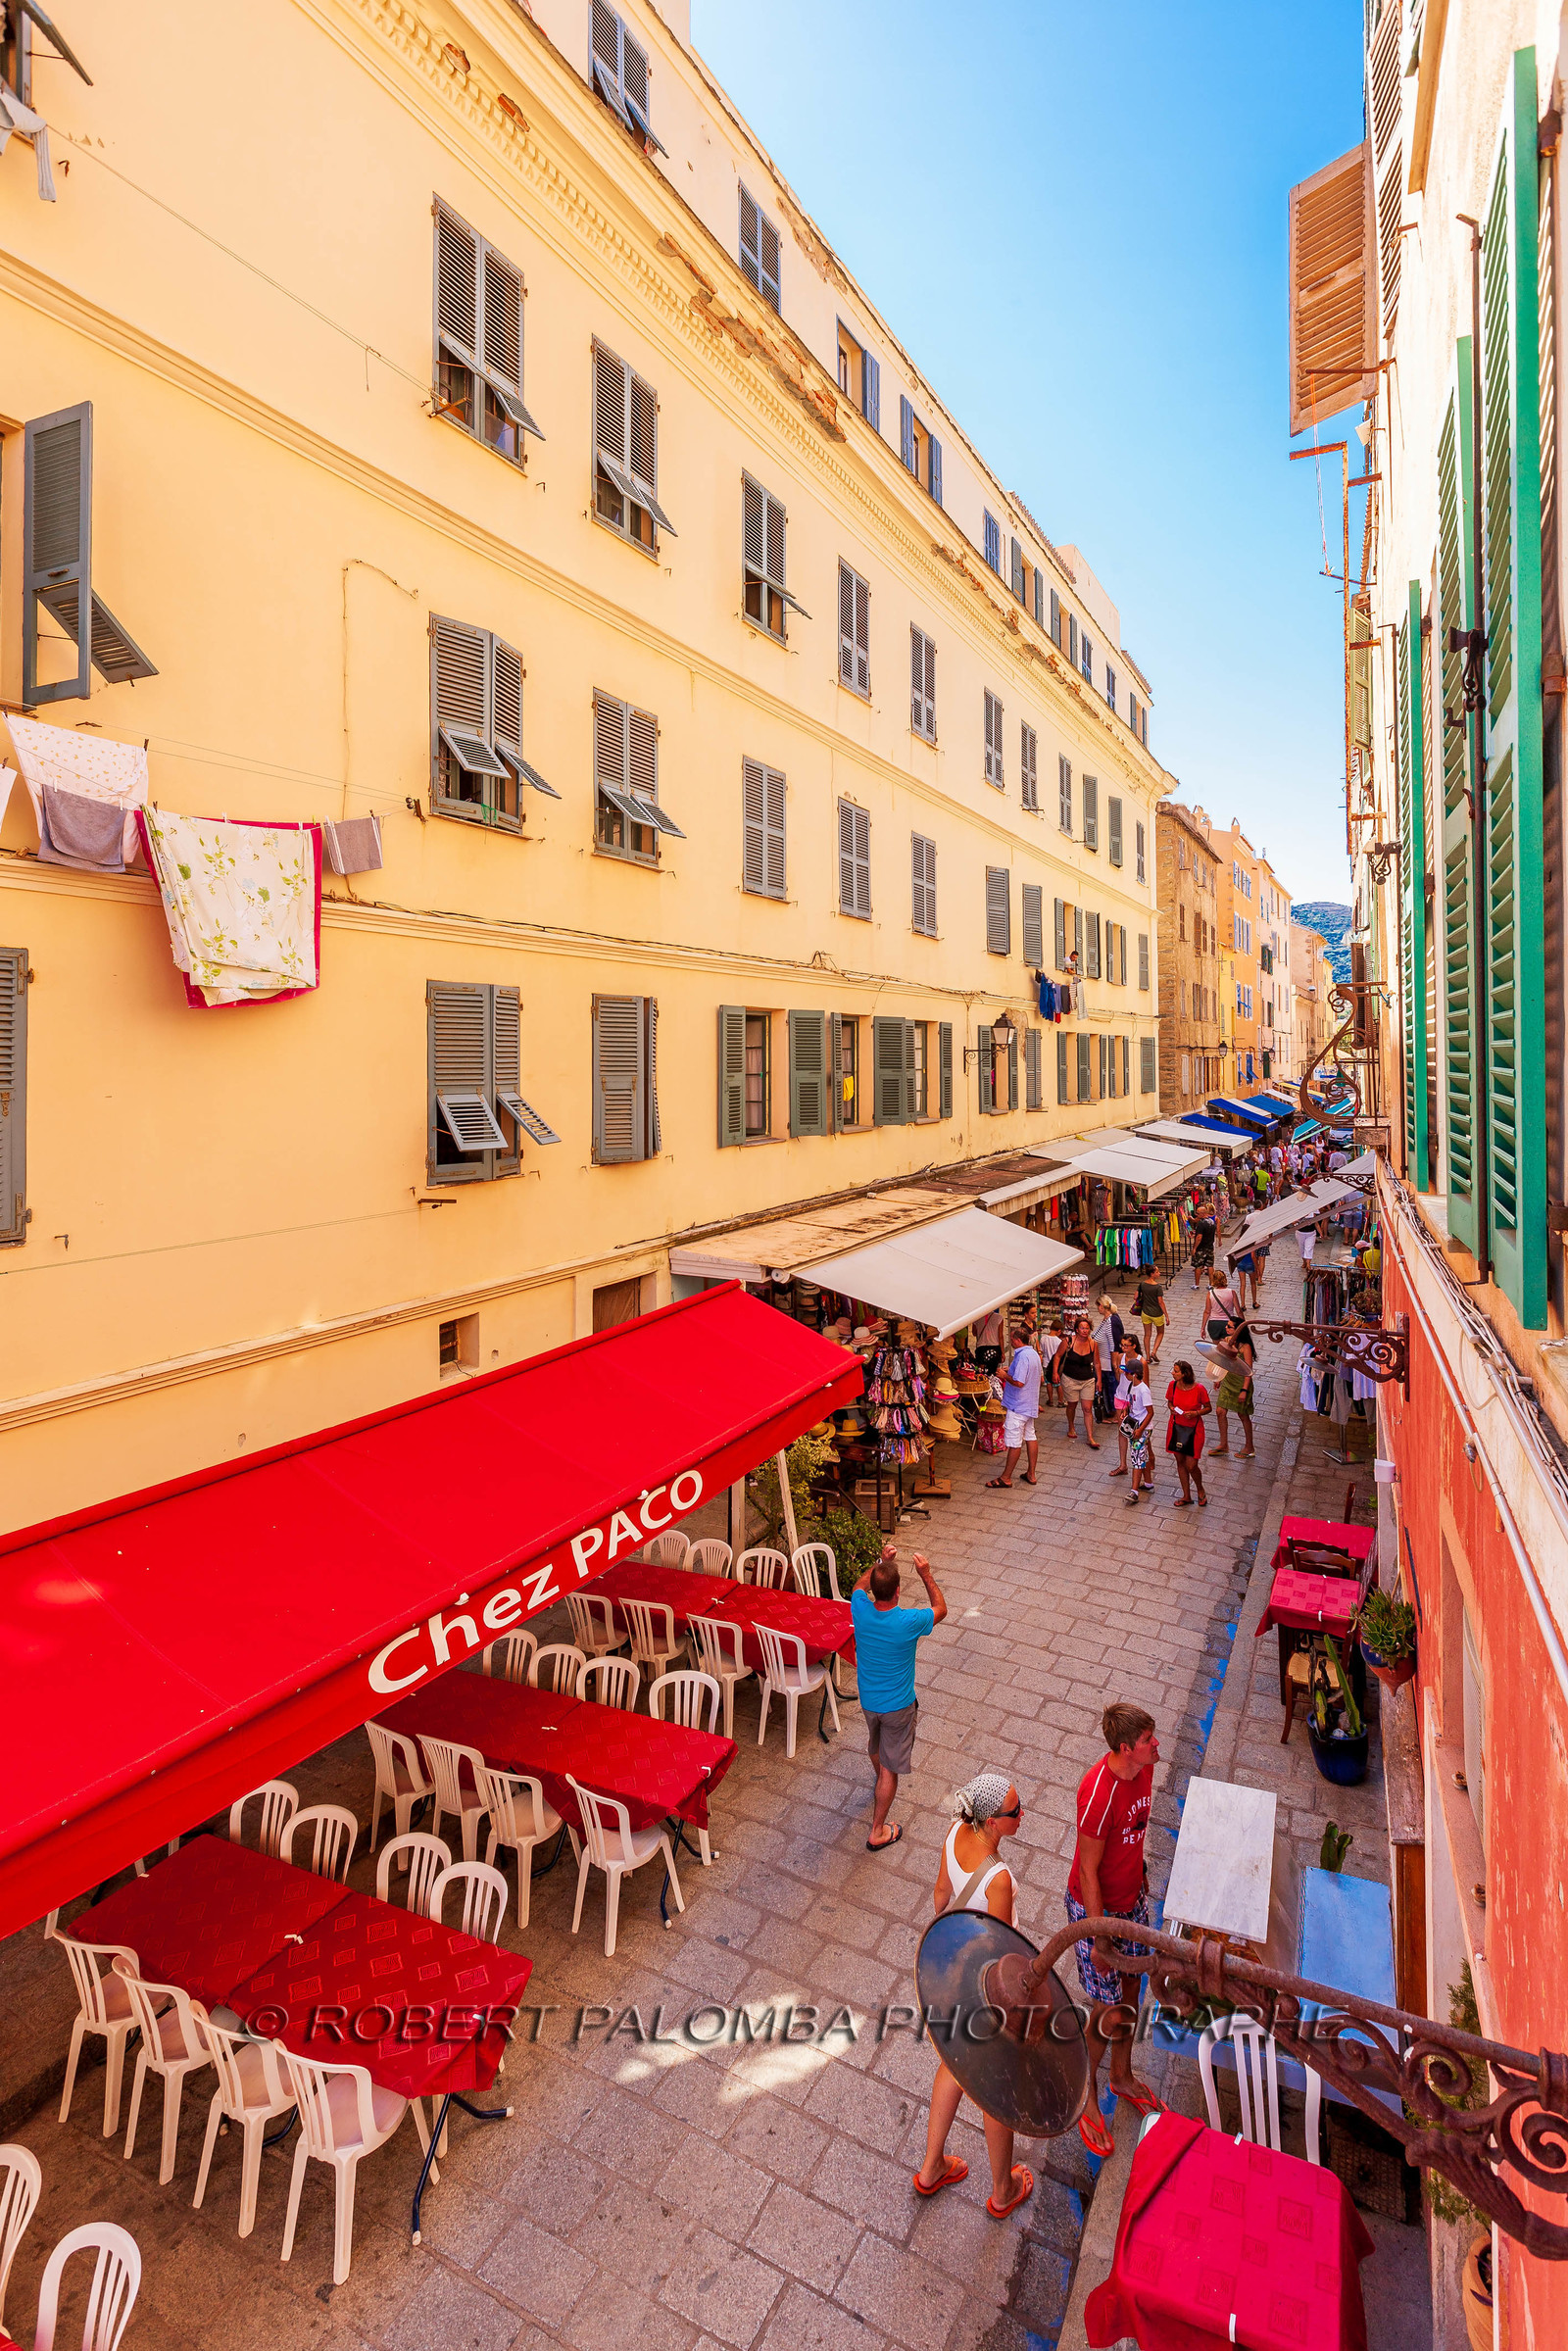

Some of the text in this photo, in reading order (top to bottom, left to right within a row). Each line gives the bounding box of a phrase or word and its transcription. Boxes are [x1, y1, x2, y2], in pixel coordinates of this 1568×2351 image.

[368, 1470, 704, 1694] Chez PACO
[1127, 1795, 1151, 1822] JONES
